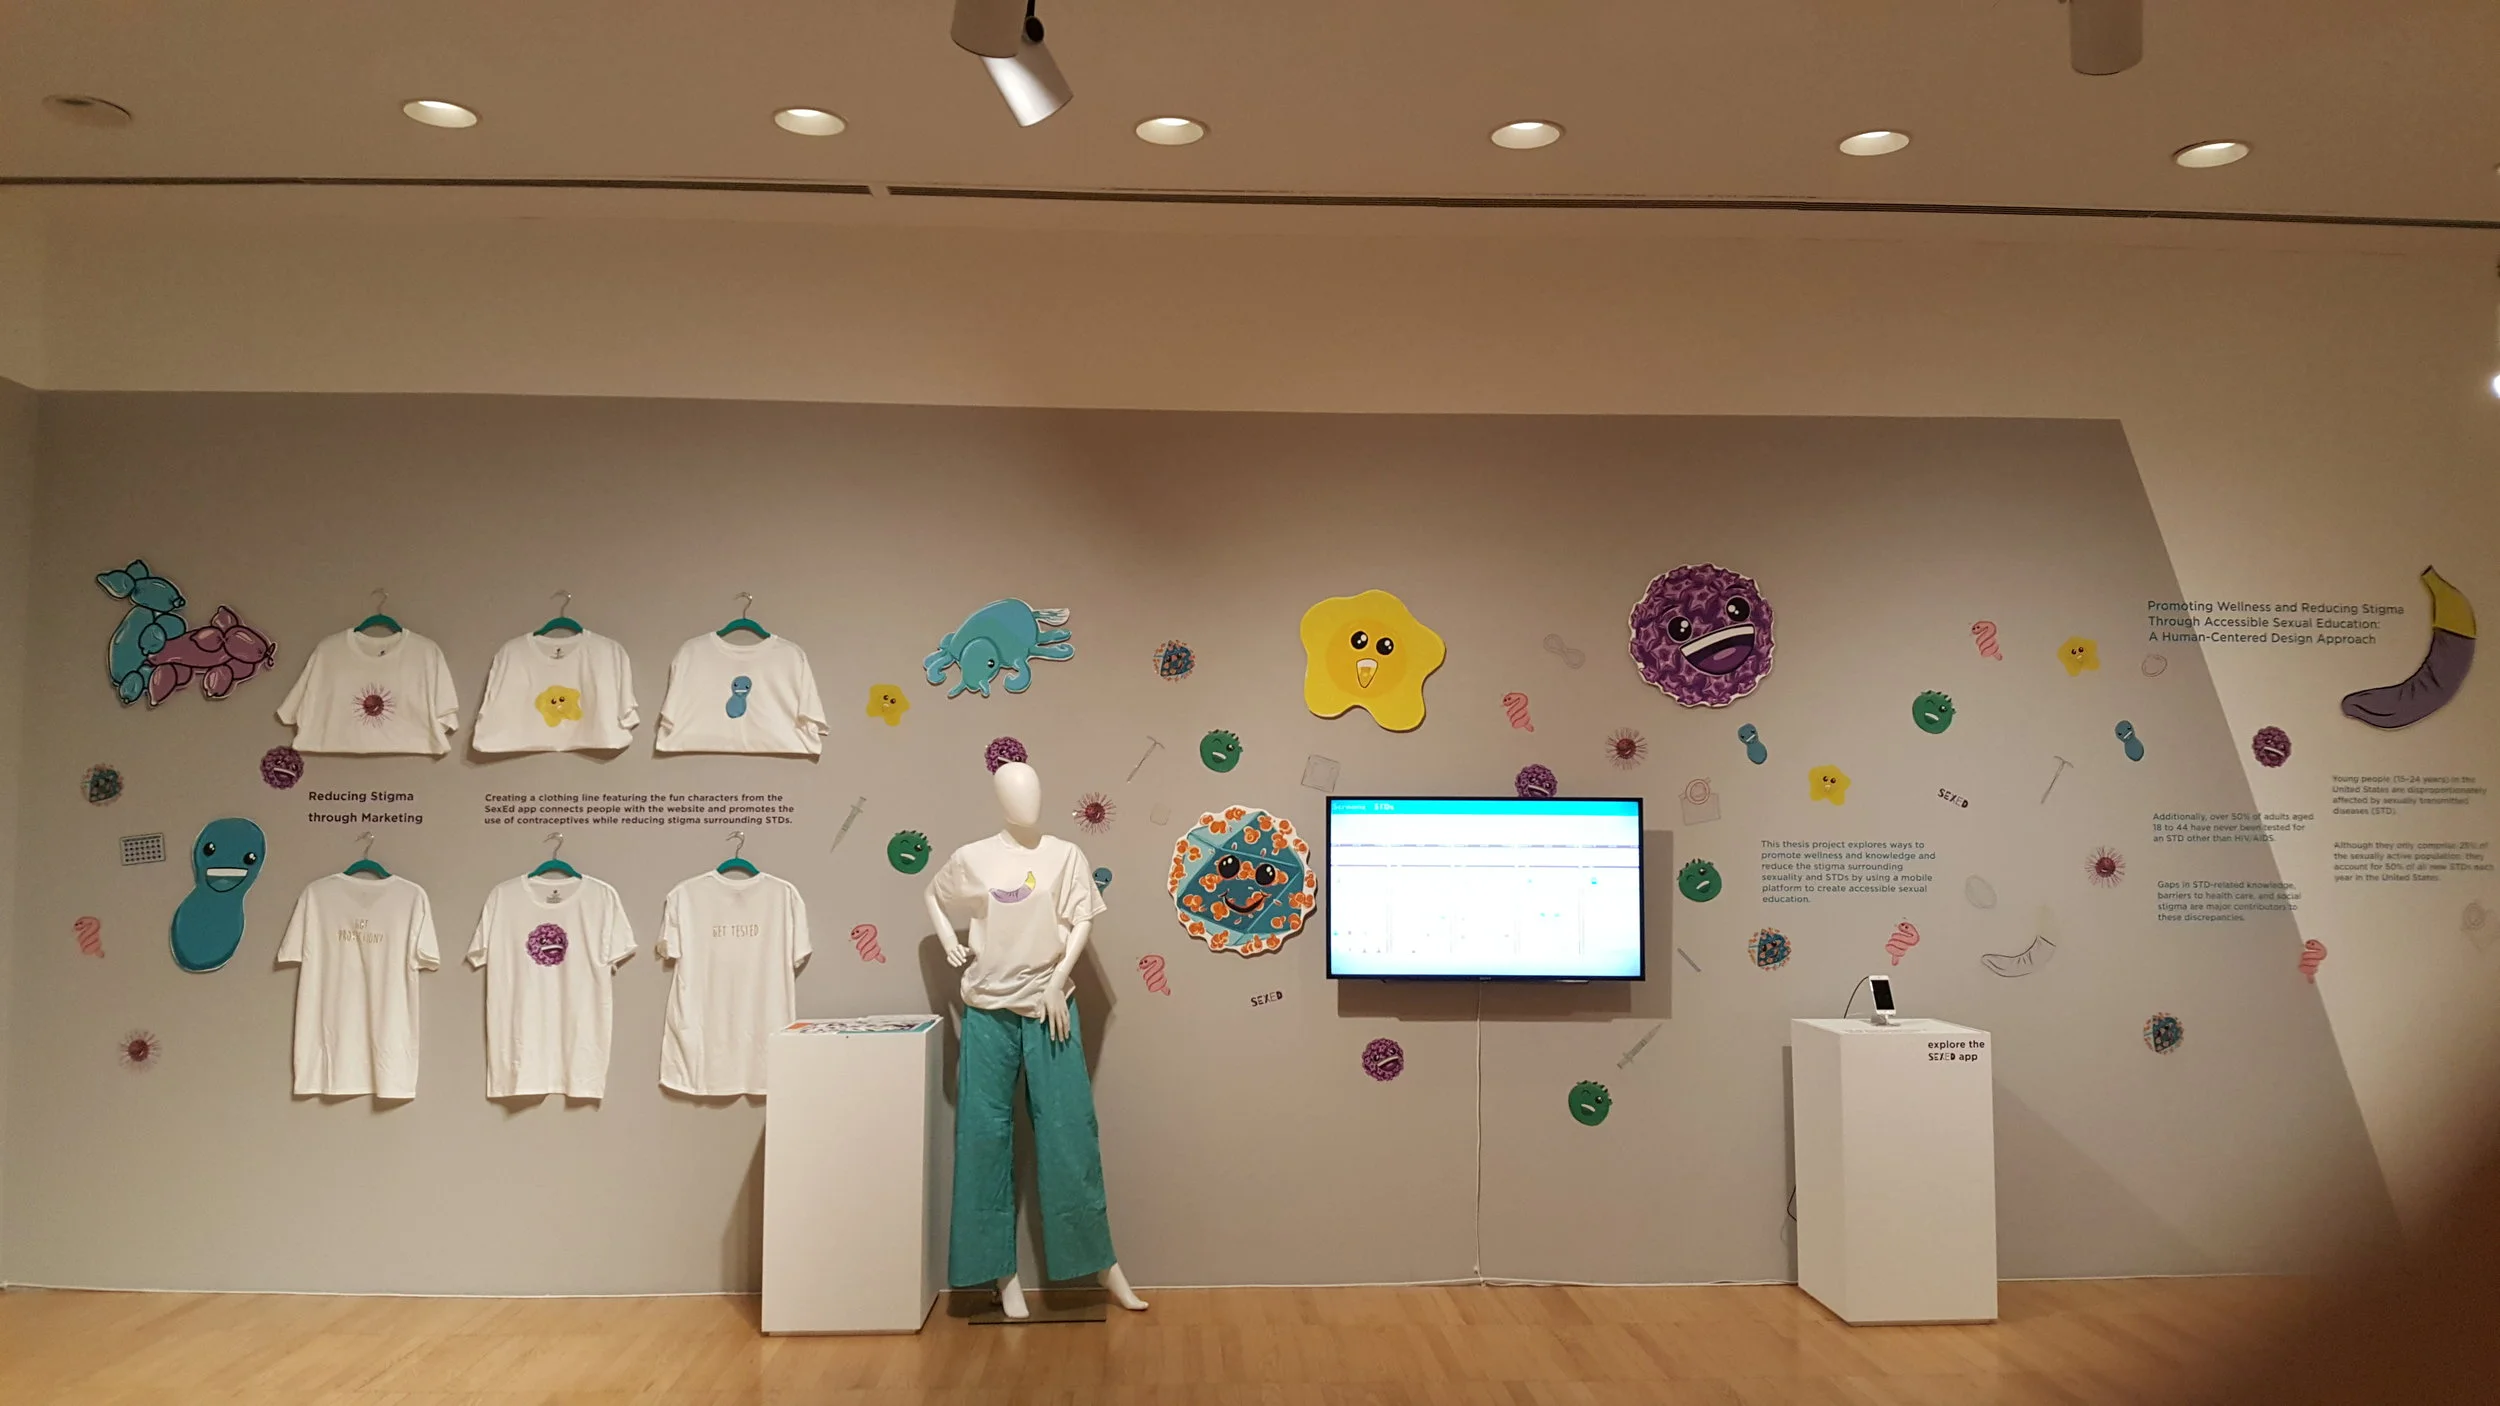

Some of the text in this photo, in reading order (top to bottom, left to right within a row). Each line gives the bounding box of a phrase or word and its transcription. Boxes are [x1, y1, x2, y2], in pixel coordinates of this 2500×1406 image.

[2148, 601, 2405, 616] Promoting Wellness and Reducing Stigma
[2148, 616, 2381, 629] Through Accessible Sexual Education:
[2149, 632, 2377, 646] A Human-Centered Design Approach
[2332, 776, 2359, 784] Young
[2362, 776, 2390, 784] people
[2332, 786, 2360, 794] United
[2363, 786, 2389, 794] States
[2407, 786, 2487, 795] disproportionately
[309, 791, 414, 802] Reducing Stigma
[485, 794, 527, 803] Creating
[538, 794, 579, 803] clothing
[603, 794, 647, 803] featuring
[1937, 788, 1969, 808] SEXED
[2333, 796, 2469, 805] affected by sexually transmitted
[587, 805, 621, 814] people
[729, 805, 776, 814] promotes
[2333, 807, 2369, 815] diseases
[308, 813, 423, 824] through Marketing
[517, 816, 589, 825] contraceptives
[621, 816, 665, 825] reducing
[668, 816, 701, 825] stigma
[704, 816, 763, 825] surrounding
[2153, 813, 2208, 822] Additionally,
[2231, 813, 2250, 821] 50%
[2253, 813, 2261, 821] of
[2264, 813, 2289, 821] adults
[2292, 813, 2314, 822] aged
[2153, 824, 2162, 832] 18
[2165, 824, 2174, 832] to
[2176, 824, 2188, 832] 44
[2191, 824, 2211, 832] have
[2240, 824, 2262, 832] been
[2264, 824, 2290, 832] tested
[2293, 824, 2305, 832] for
[2166, 834, 2184, 842] STD
[2187, 834, 2210, 842] other
[2213, 834, 2231, 842] than
[1761, 840, 1925, 850] This thesis project explores ways to
[2334, 842, 2374, 850] Although
[2375, 842, 2393, 850] they
[2397, 842, 2415, 850] only
[1761, 851, 1800, 860] promote
[1865, 851, 1916, 860] knowledge
[2351, 853, 2384, 861] sexually
[2465, 853, 2484, 861] they
[1814, 862, 1845, 871] stigma
[1848, 862, 1904, 871] surrounding
[1762, 873, 1802, 883] sexuality
[1805, 873, 1822, 881] and
[1826, 873, 1849, 881] STDs
[1852, 873, 1863, 883] by
[1866, 873, 1890, 883] using
[1901, 873, 1933, 881] mobile
[1762, 884, 1927, 894] platform to create accessible sexual
[2158, 881, 2296, 890] Gaps in STD-related knowledge,
[2158, 891, 2191, 899] barriers
[2194, 891, 2203, 899] to
[2206, 891, 2233, 899] health
[2258, 891, 2274, 899] and
[2277, 891, 2301, 899] social
[2158, 902, 2187, 911] stigma
[2234, 902, 2286, 910] contributors
[2289, 902, 2298, 910] to
[2158, 913, 2245, 922] these discrepancies.
[712, 924, 760, 938] GET TESTED
[338, 929, 384, 944] PROTION?
[1250, 991, 1283, 1007] SEXED
[1928, 1040, 1985, 1050] explore the
[1928, 1052, 1978, 1062] SEXED app
